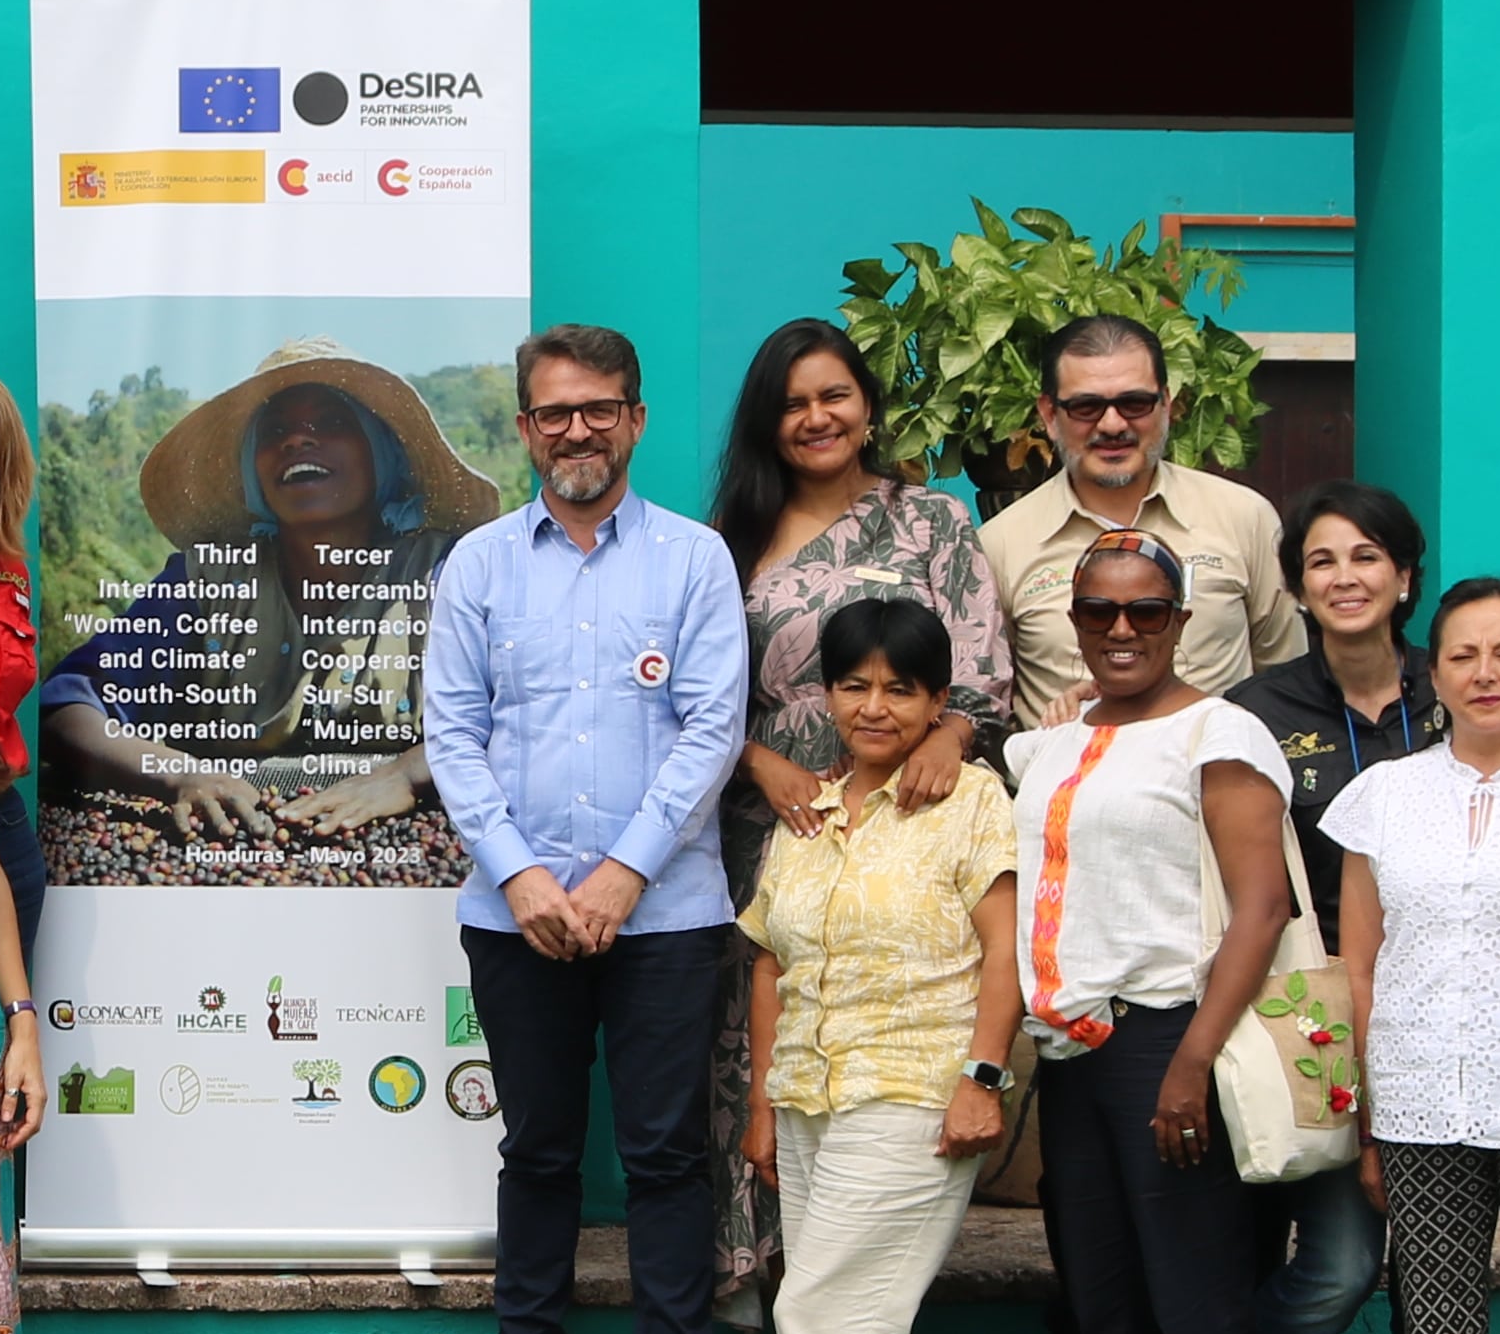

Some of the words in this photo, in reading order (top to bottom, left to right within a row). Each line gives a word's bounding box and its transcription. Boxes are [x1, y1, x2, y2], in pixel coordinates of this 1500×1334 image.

[359, 72, 483, 99] DeSIRA
[360, 104, 453, 115] PARTNERSHIPS
[360, 116, 386, 127] FOR
[389, 116, 468, 127] INNOVATION
[316, 170, 353, 183] aecid
[418, 164, 493, 177] Cooperación
[418, 178, 472, 191] Española
[193, 542, 257, 565] Third
[314, 544, 394, 566] Tercer
[99, 577, 258, 599] International
[302, 578, 436, 600] Intercambi
[175, 612, 259, 635] Coffee
[302, 614, 432, 636] Internacio
[99, 647, 143, 670] and
[302, 649, 427, 674] Cooperaci
[101, 682, 257, 705] South-South
[302, 684, 394, 706] Sur-Sur
[103, 718, 257, 743] Cooperation
[140, 753, 258, 780] Exchange
[185, 845, 285, 864] Honduras
[309, 847, 366, 868] Mayo
[371, 846, 422, 865] 2023
[77, 1005, 163, 1020] CONACAFE
[177, 1014, 247, 1028] IHCAFE
[283, 1020, 294, 1030] EN
[88, 1087, 128, 1096] WOMEN
